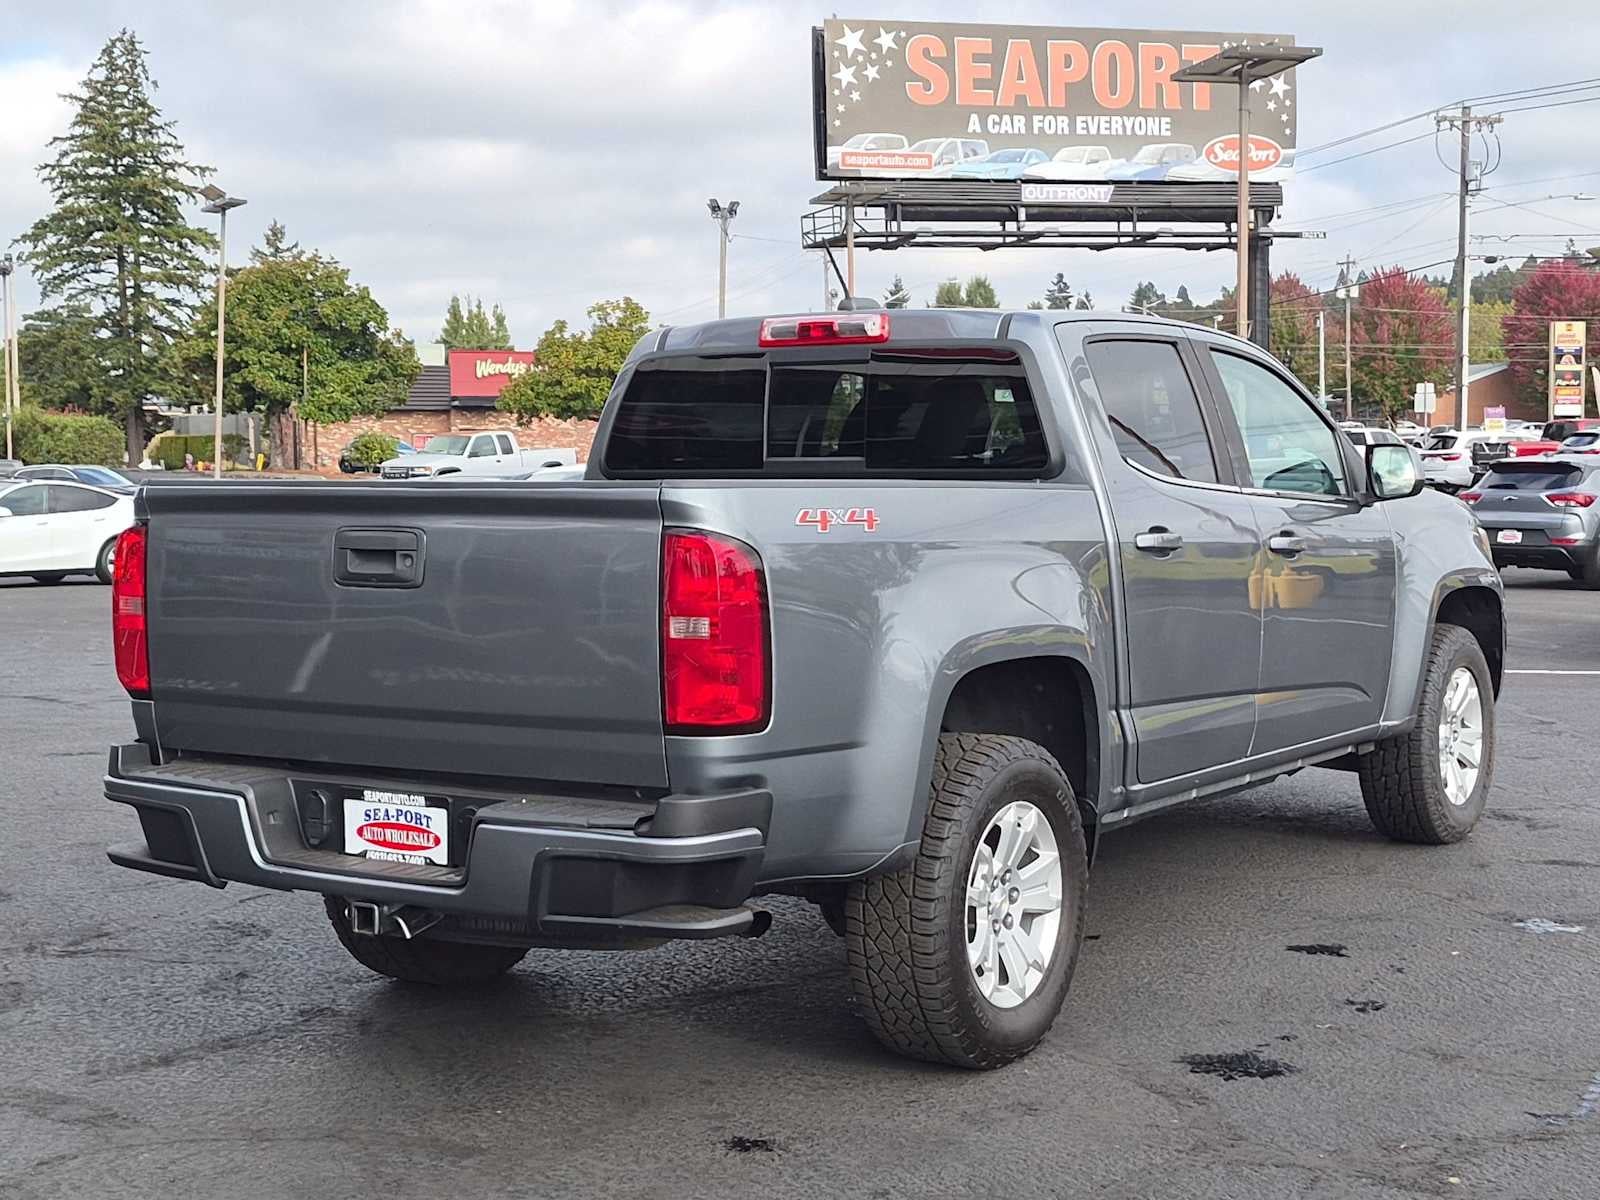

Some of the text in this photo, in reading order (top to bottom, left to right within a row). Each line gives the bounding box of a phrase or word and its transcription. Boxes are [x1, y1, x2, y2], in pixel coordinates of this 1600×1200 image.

[905, 33, 1221, 111] SEAPORT
[967, 113, 1172, 137] A CAR FOR EVERYONE
[845, 154, 930, 168] seaportauto.com
[1024, 184, 1107, 200] OUTFRONT
[476, 356, 527, 378] Wendy's
[363, 808, 432, 828] SEA-PORT
[362, 826, 436, 847] AUTO WHOLESALE
